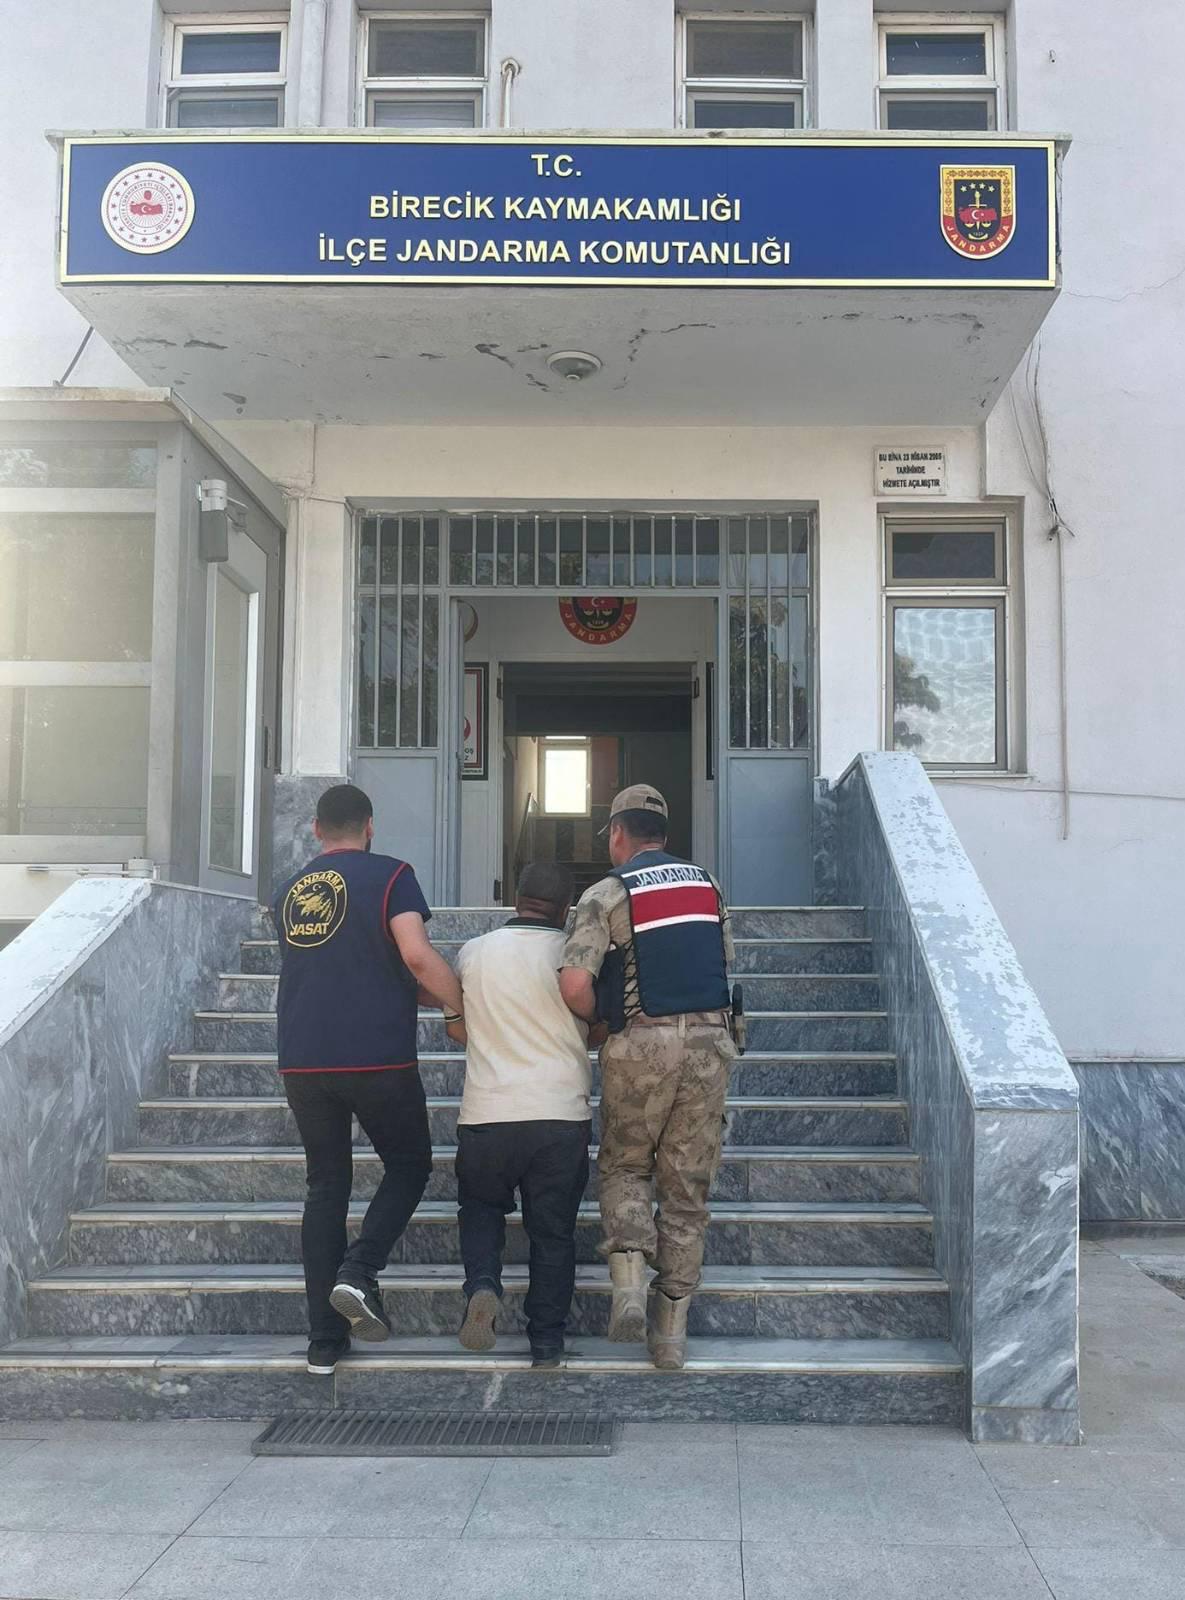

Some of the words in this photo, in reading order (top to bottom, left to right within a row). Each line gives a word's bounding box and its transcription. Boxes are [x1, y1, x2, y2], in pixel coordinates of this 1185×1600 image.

[531, 154, 582, 176] T.C.
[370, 190, 495, 219] BİRECİK
[505, 193, 741, 221] KAYMAKAMLIĞI
[319, 233, 387, 266] İLÇE
[396, 239, 571, 263] JANDARMA
[580, 236, 790, 265] KOMUTANLIĞI
[946, 225, 1010, 252] JANDARMA
[879, 453, 887, 461] BU
[888, 452, 902, 461] BİNA
[911, 451, 928, 461] NİSAN
[896, 465, 925, 474] TARİHİNDE
[882, 478, 907, 488] HİZMETE
[908, 479, 940, 489] AÇILMIŞTIR
[565, 612, 632, 642] JANDARMA
[292, 872, 343, 898] JANDARMA
[635, 867, 705, 887] JANDARMA
[290, 923, 329, 937] JASAT
